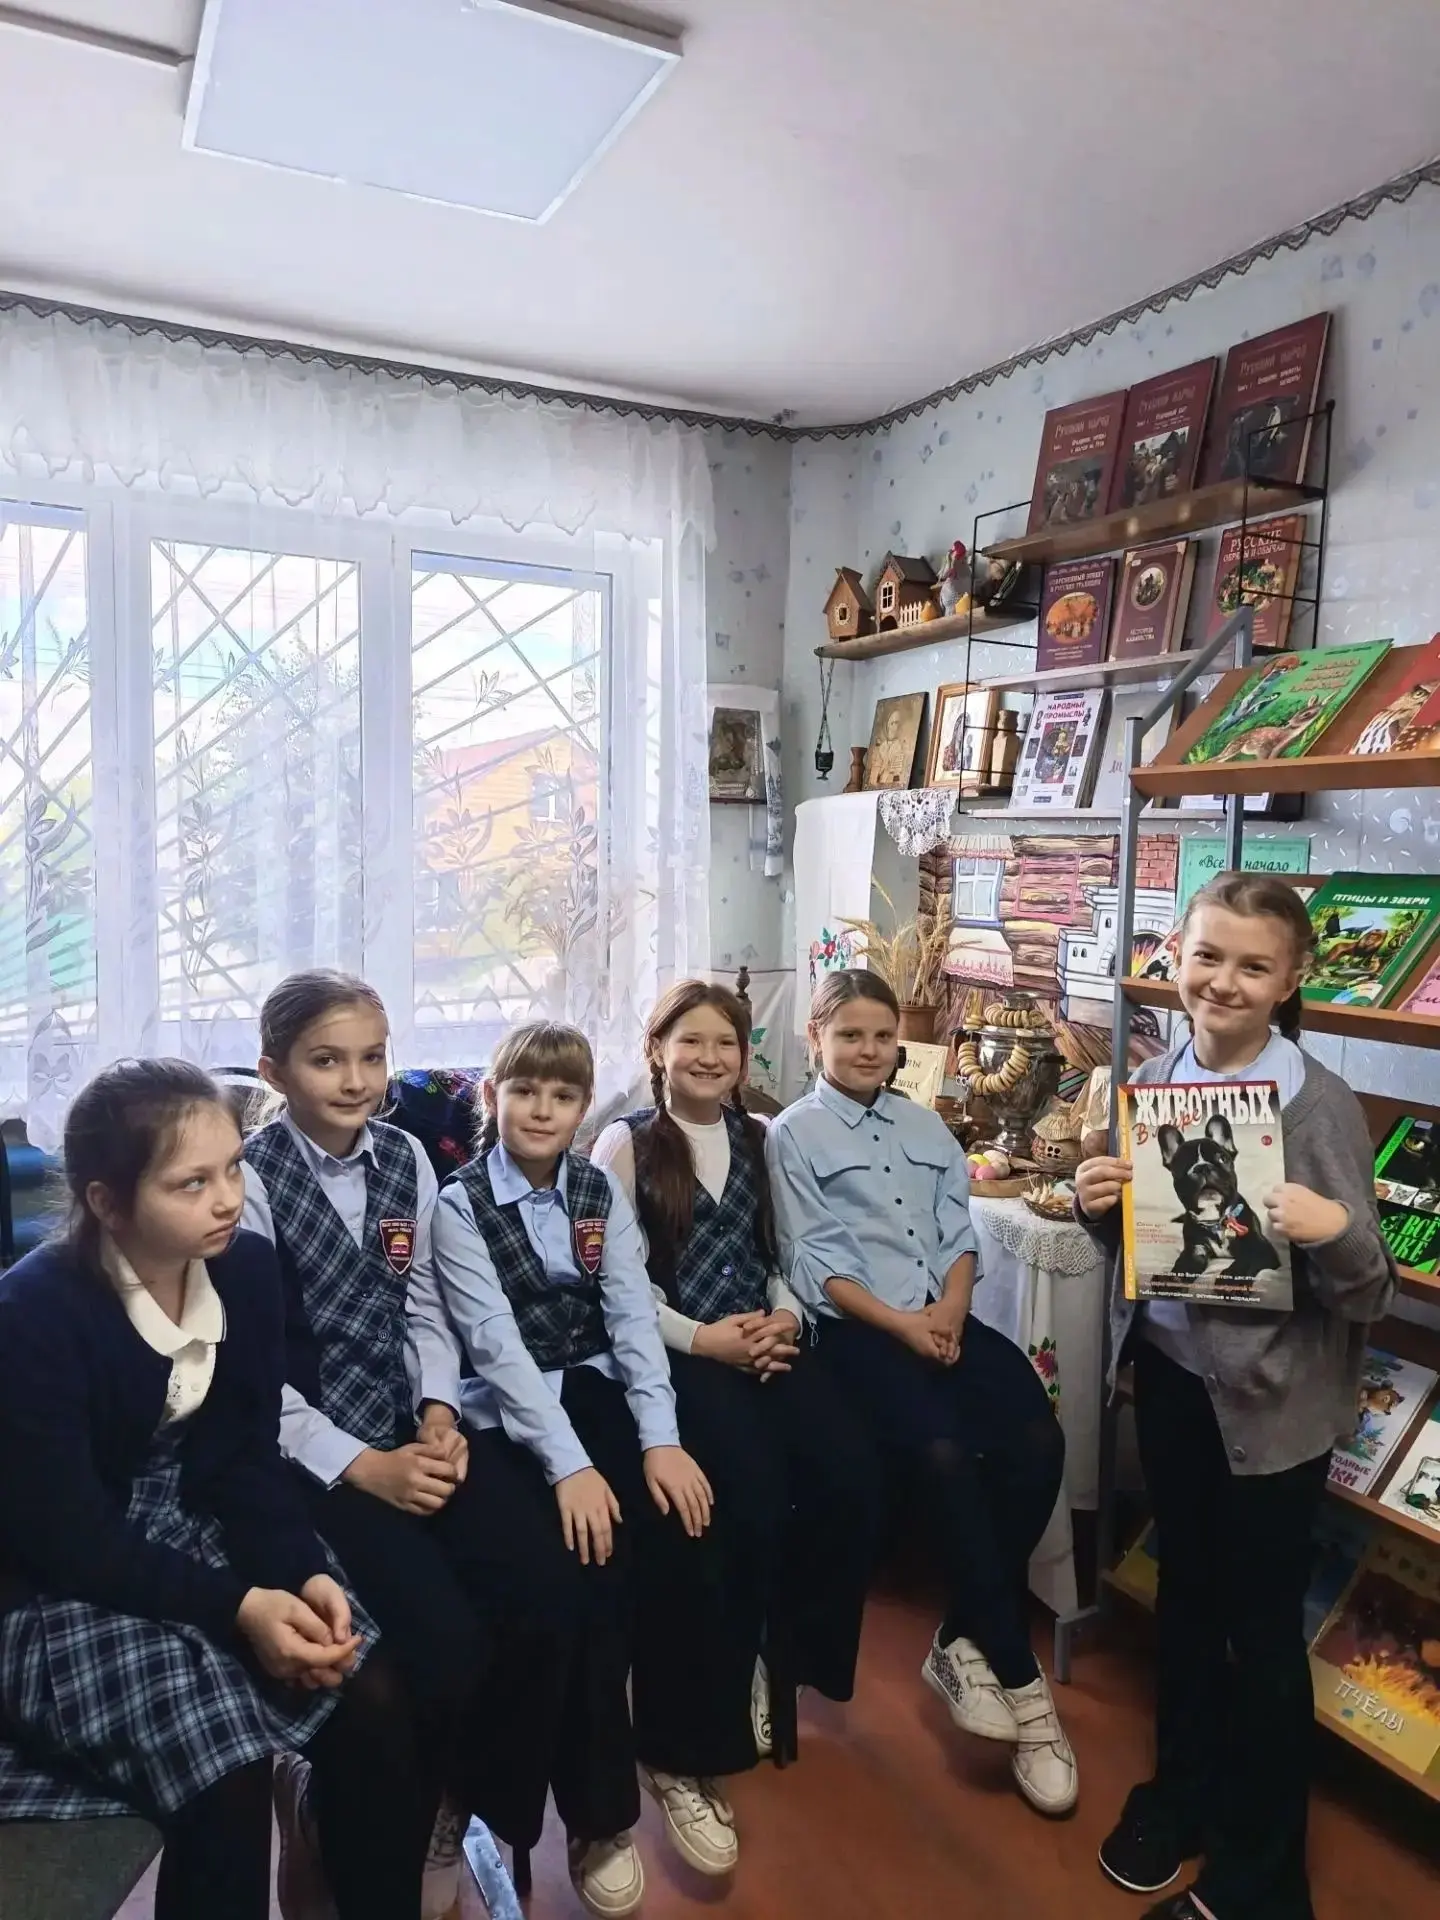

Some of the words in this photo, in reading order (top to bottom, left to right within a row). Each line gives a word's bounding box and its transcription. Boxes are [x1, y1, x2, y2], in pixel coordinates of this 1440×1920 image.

[1047, 701, 1086, 710] НАРОДНЫЕ
[1043, 710, 1085, 719] ПРОМЫСЛЫ
[1245, 860, 1290, 872] начало
[1332, 893, 1377, 903] ПТИЦЫ
[1377, 896, 1389, 904] И
[1389, 896, 1431, 905] ЗВЕРИ
[1134, 1085, 1276, 1126] ЖИВОТНЫХ
[1132, 1122, 1149, 1145] В
[1335, 1678, 1405, 1734] ПЧЁЛЫ
